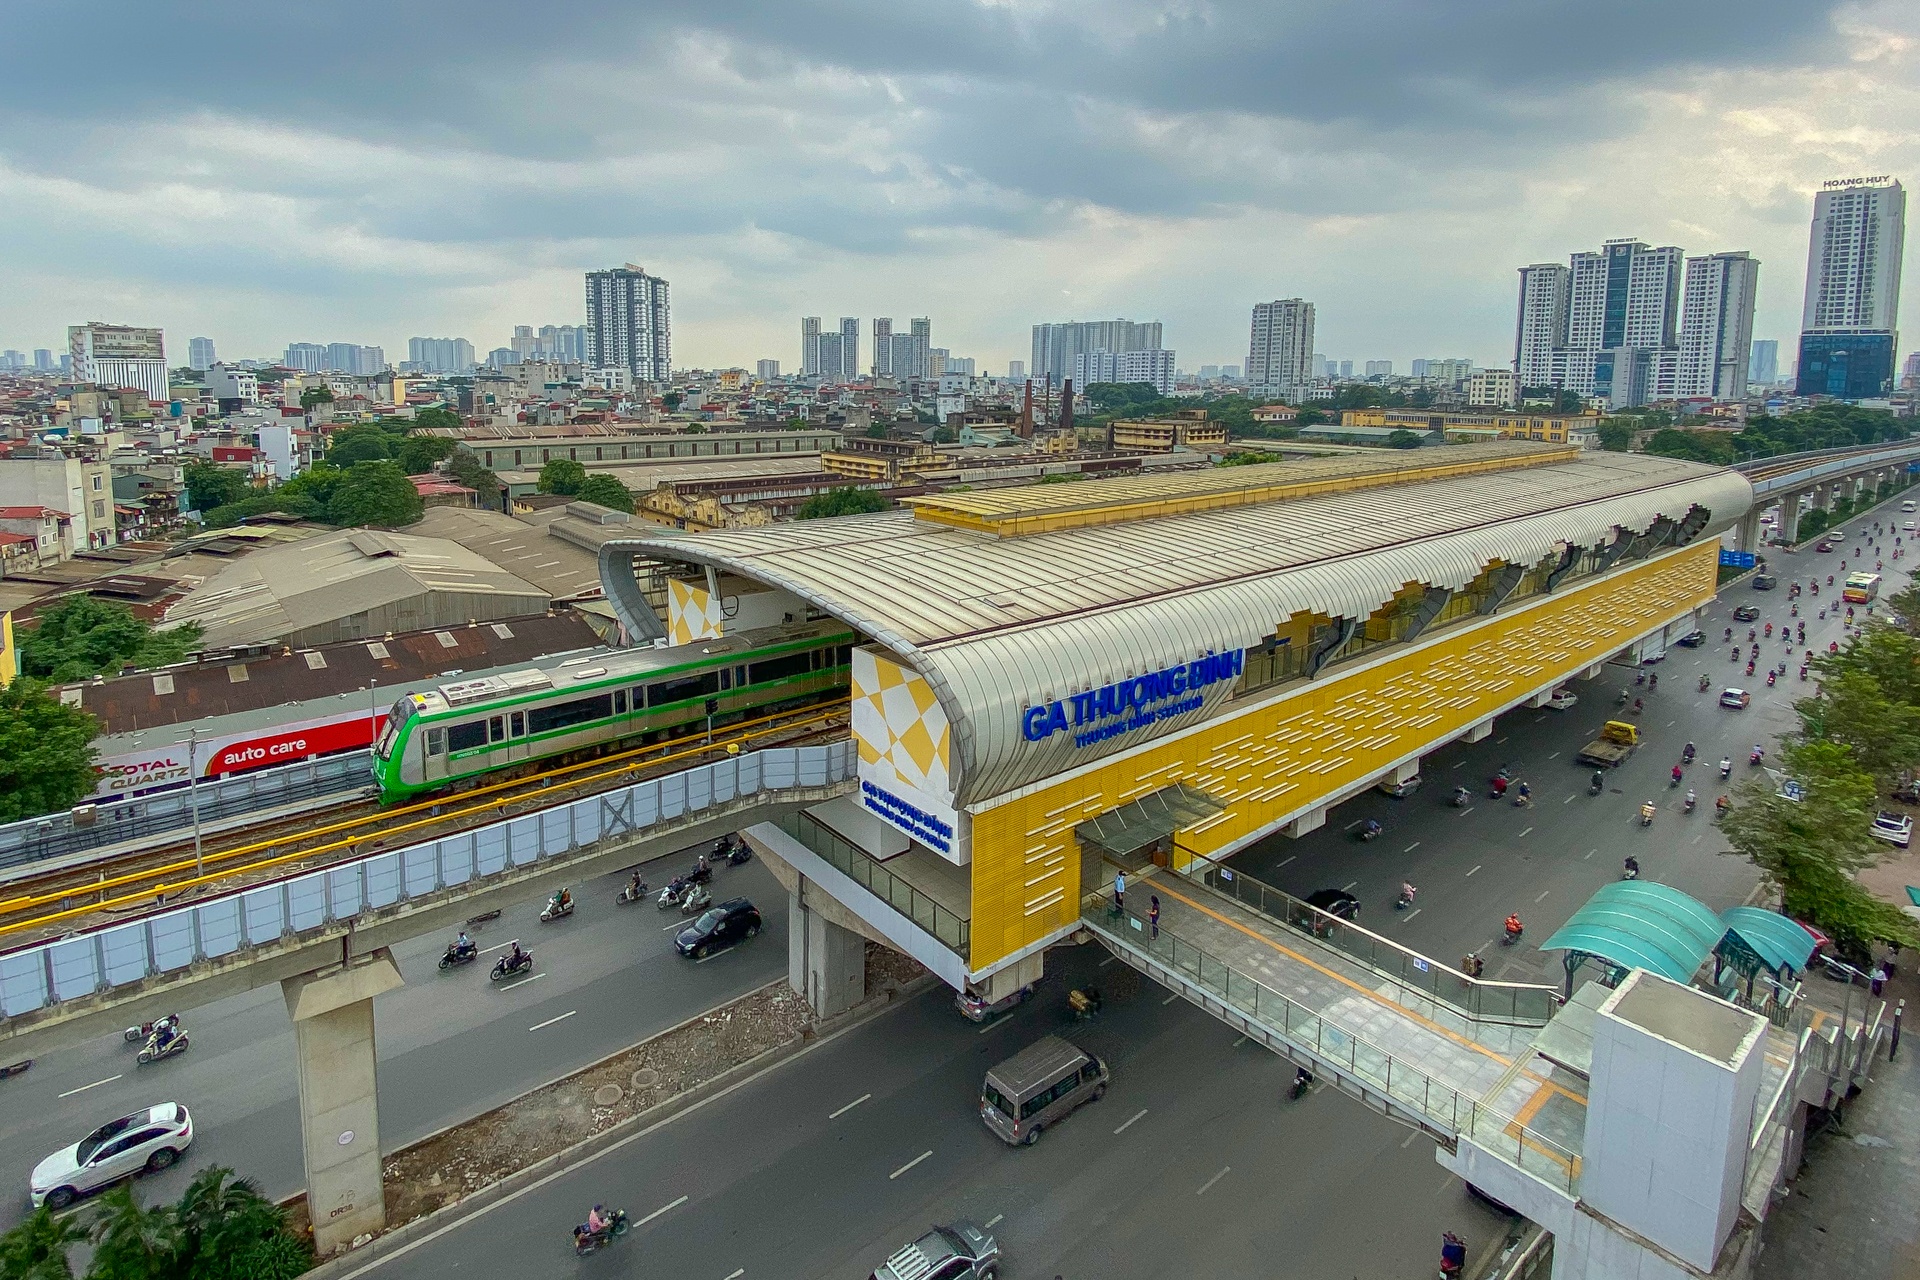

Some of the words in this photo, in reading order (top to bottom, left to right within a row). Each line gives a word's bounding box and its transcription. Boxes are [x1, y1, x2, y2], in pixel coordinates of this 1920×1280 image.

[1866, 175, 1890, 184] HUY
[1023, 700, 1069, 742] GA
[1189, 647, 1244, 691] ĐÌNH
[1159, 695, 1203, 721] STATION
[224, 747, 265, 765] auto
[269, 739, 307, 756] care
[108, 758, 179, 777] TOTAL
[110, 766, 190, 790] QUARTZ
